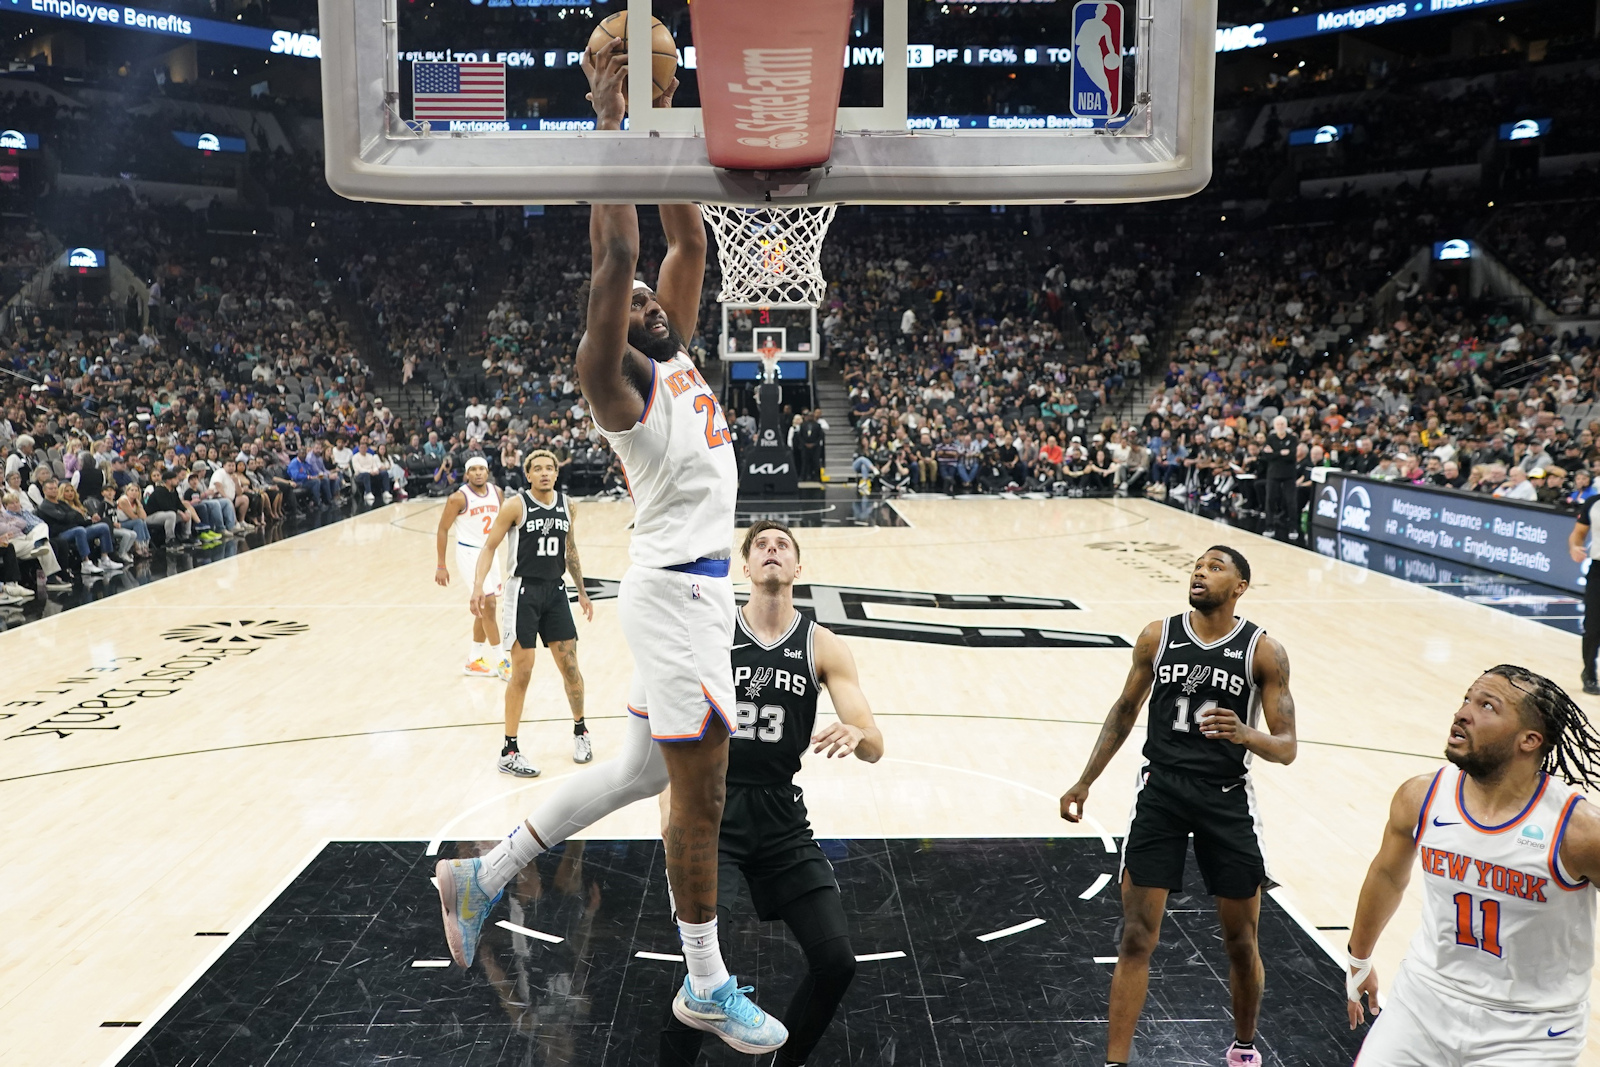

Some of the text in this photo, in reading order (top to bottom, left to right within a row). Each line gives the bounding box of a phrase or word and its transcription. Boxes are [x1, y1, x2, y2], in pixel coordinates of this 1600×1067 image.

[31, 0, 192, 35] Employee Benefits
[1316, 2, 1407, 31] Mortgages
[270, 30, 321, 59] SWB
[935, 48, 958, 63] PF
[978, 48, 1018, 64] FG%
[1046, 48, 1071, 63] TO
[1078, 92, 1101, 110] NBA
[450, 121, 510, 132] Mortgages
[540, 119, 595, 131] Insurance
[939, 116, 960, 129] Tax
[988, 116, 1095, 130] Employee Benefits
[482, 516, 492, 535] 2
[526, 518, 570, 536] SPURS
[1341, 505, 1371, 532] SWBC
[1392, 498, 1548, 544] Mortgages Insurance Real Estate
[536, 537, 559, 556] 10
[1385, 518, 1551, 572] HR Property Tax Employee Benefits
[735, 666, 808, 699] PURS
[1158, 663, 1245, 697] SPURS
[731, 701, 785, 744] 23
[1172, 696, 1220, 735] 14
[1516, 837, 1546, 850] sphere
[1421, 845, 1548, 903] NEW YORK
[1453, 891, 1503, 959] 11
